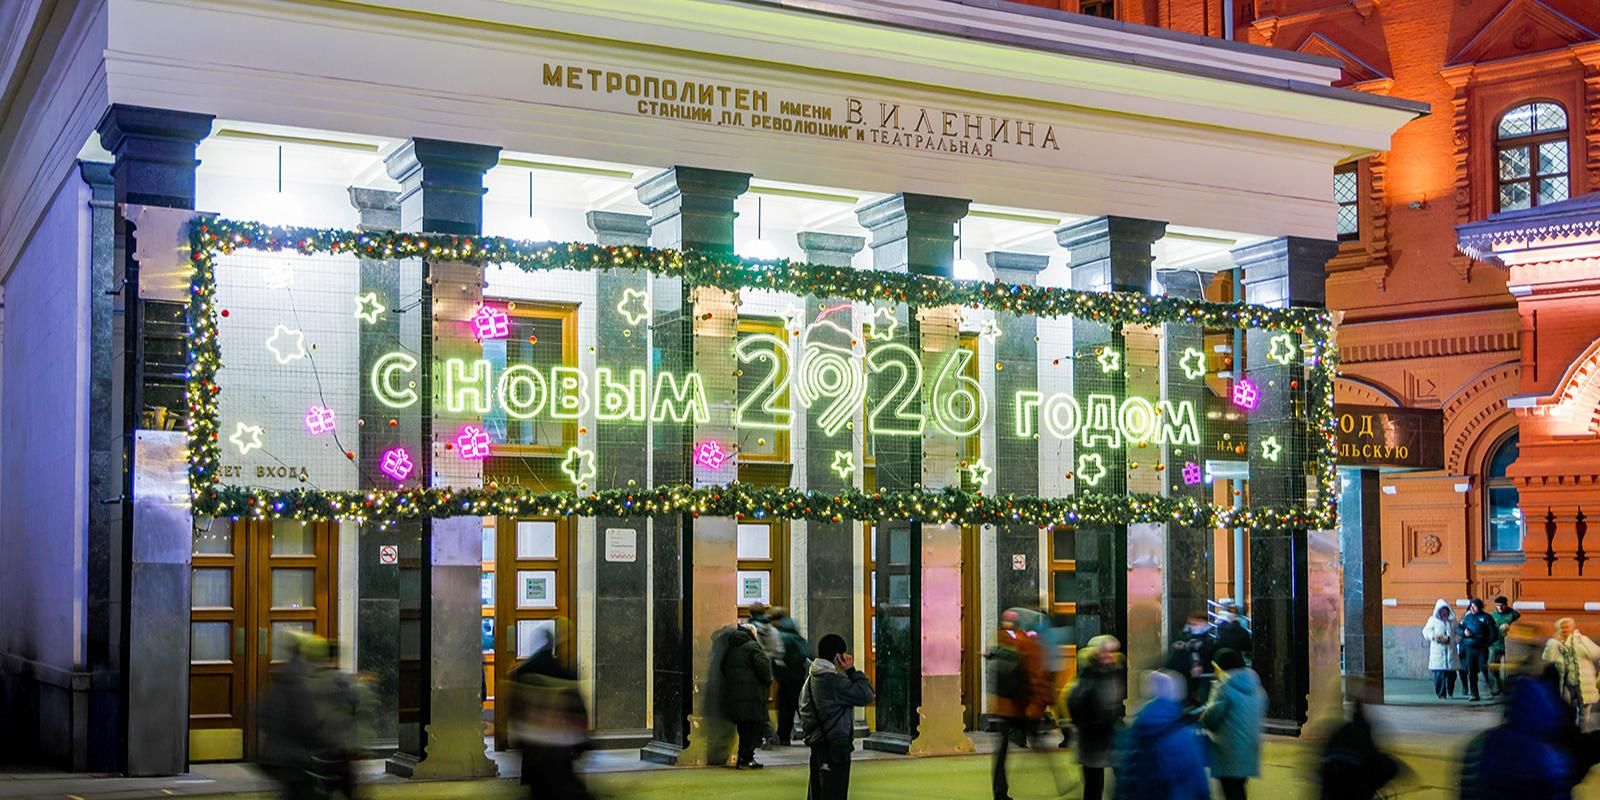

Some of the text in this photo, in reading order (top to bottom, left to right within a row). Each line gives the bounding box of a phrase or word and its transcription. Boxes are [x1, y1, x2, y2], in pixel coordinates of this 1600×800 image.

[543, 63, 1060, 150] МЕТРОПОЛИТЕН ИМЕНИ В. И. ЛЕНИНА
[637, 100, 712, 123] СТАНЦИИ
[857, 129, 865, 141] И
[870, 128, 993, 157] ТЕАТРАЛЬНАЯ
[371, 332, 1200, 448] С НОВЫМ 2026 ГОДОМ
[1339, 443, 1409, 460] ЛЬСКУЮ
